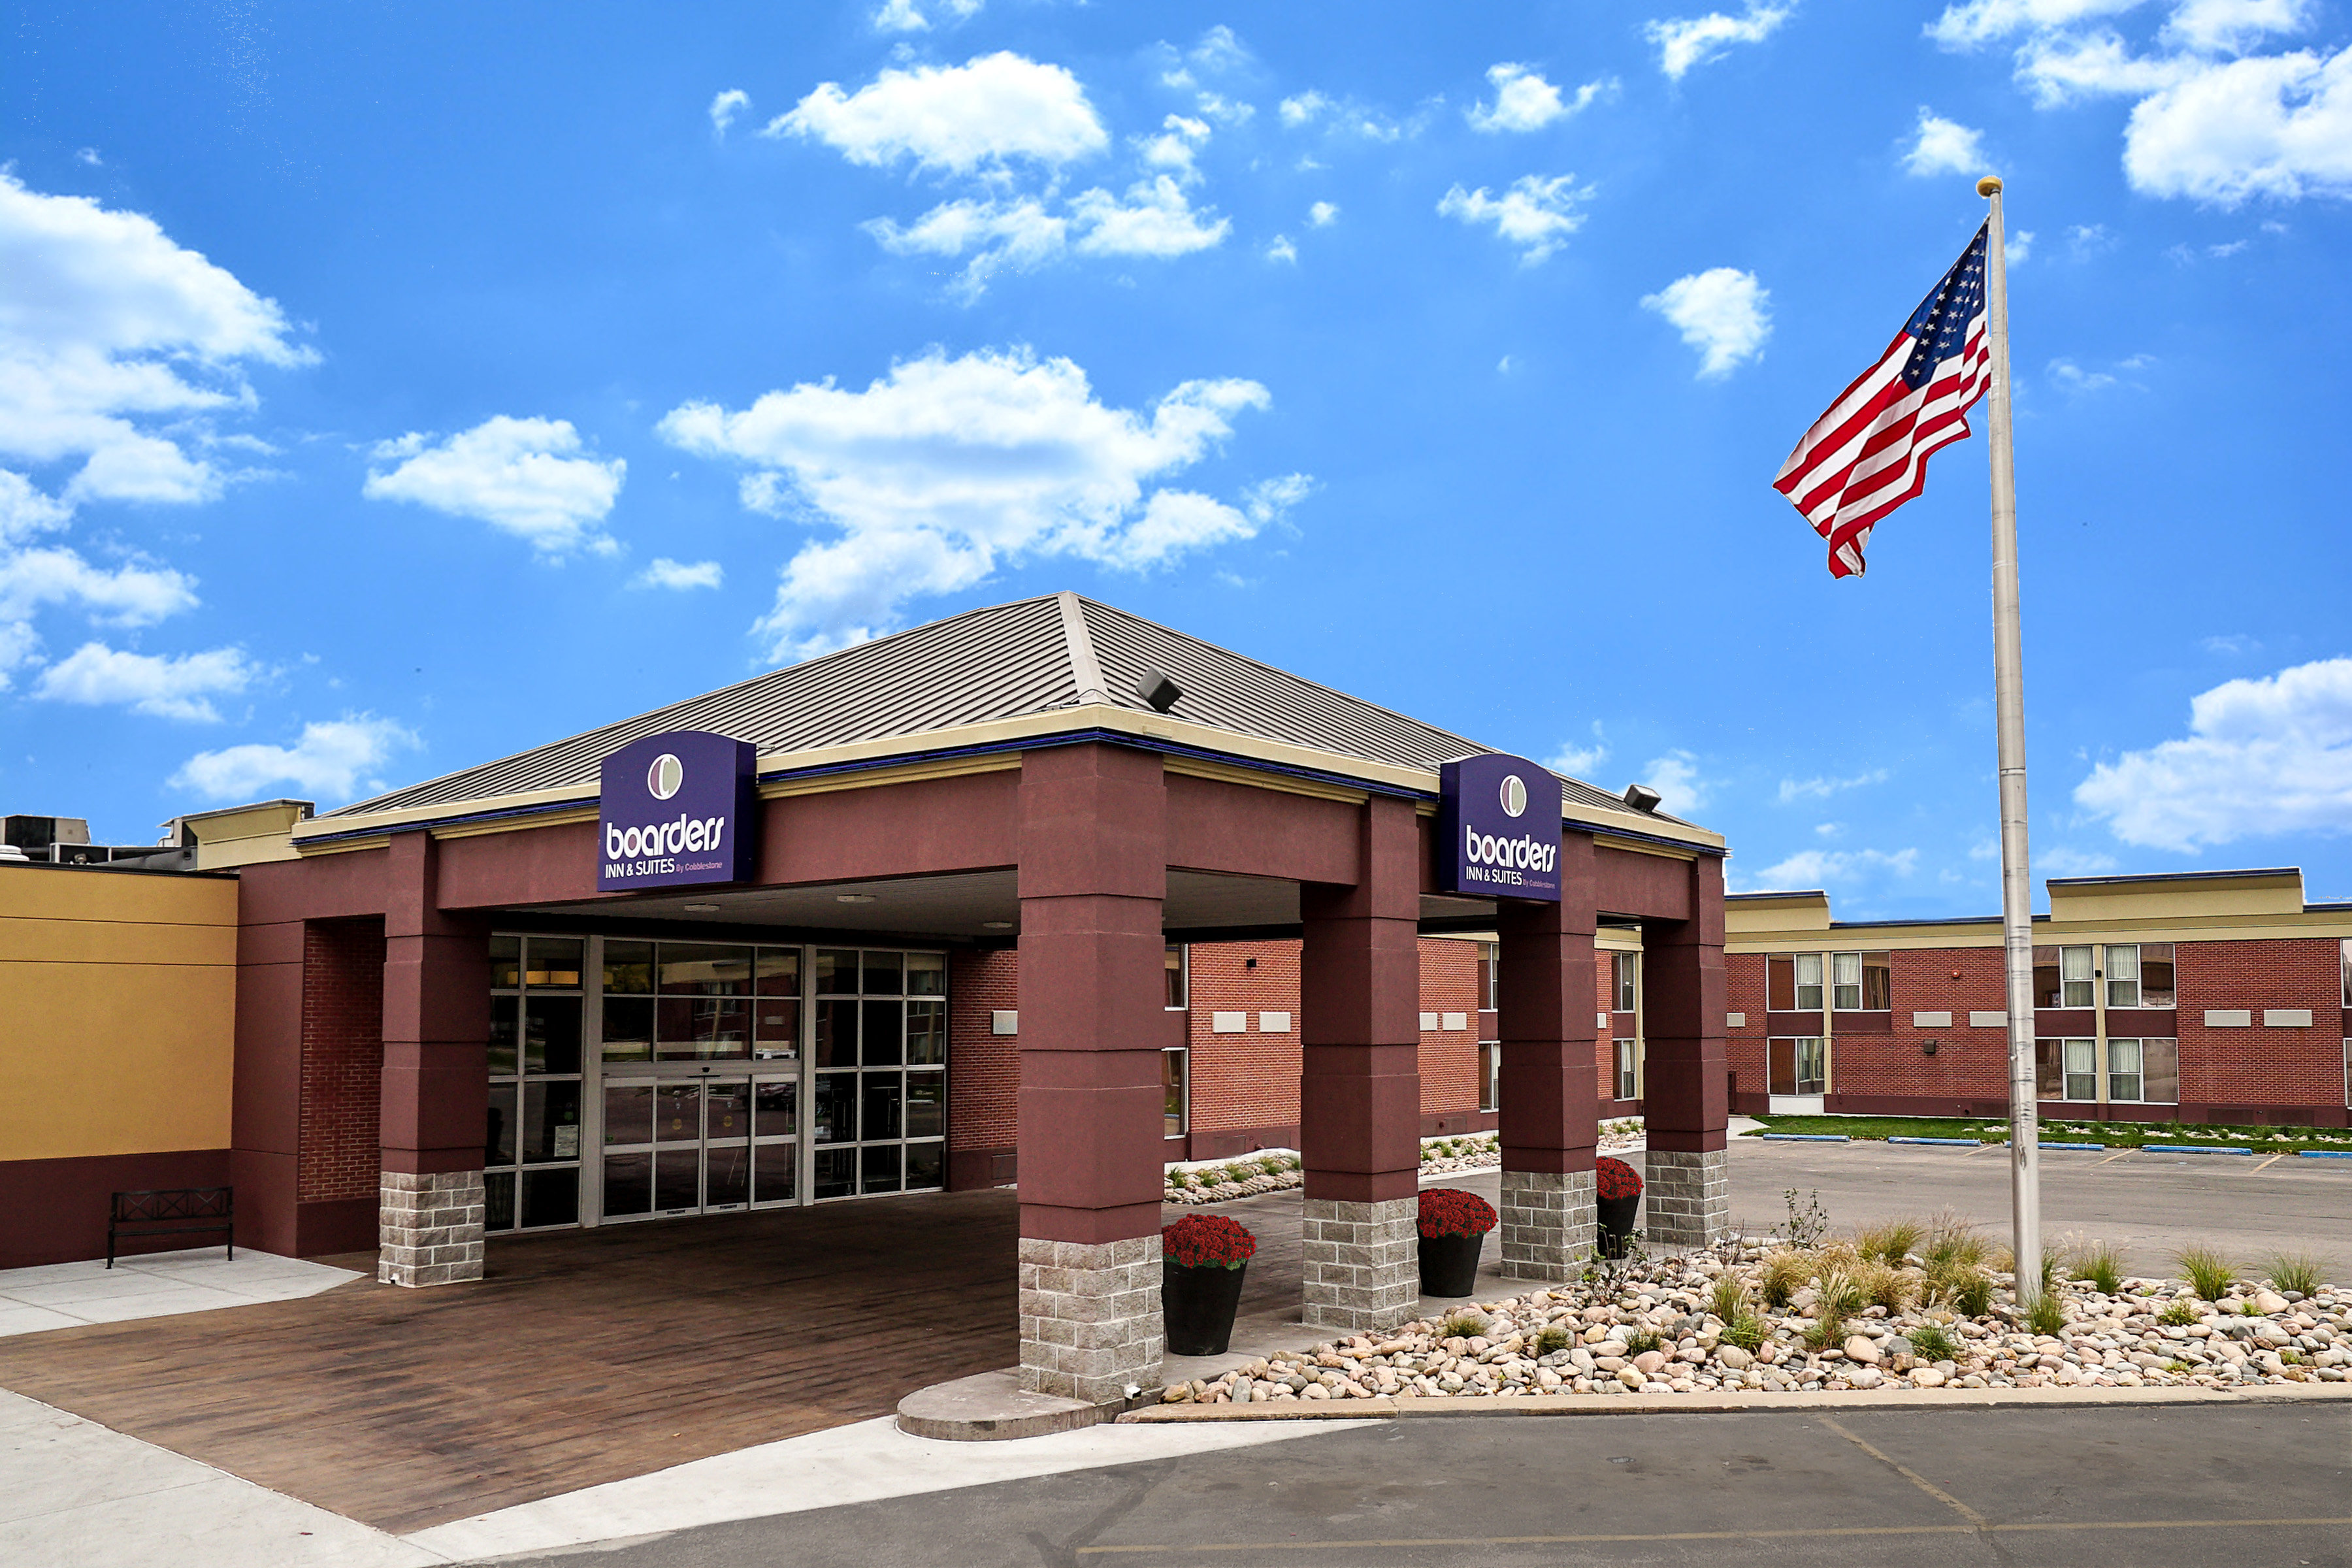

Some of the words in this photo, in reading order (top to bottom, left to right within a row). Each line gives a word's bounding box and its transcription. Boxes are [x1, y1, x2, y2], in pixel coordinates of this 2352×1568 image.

[606, 813, 725, 860] boarders
[1466, 825, 1556, 873] boarders
[605, 862, 625, 878] INN
[627, 863, 634, 877] &
[636, 858, 675, 875] SUITES
[676, 864, 684, 874] By
[685, 862, 723, 872] Cobblestone
[1466, 866, 1482, 881] INN
[1484, 869, 1490, 881] &
[1492, 868, 1522, 886] SUITES
